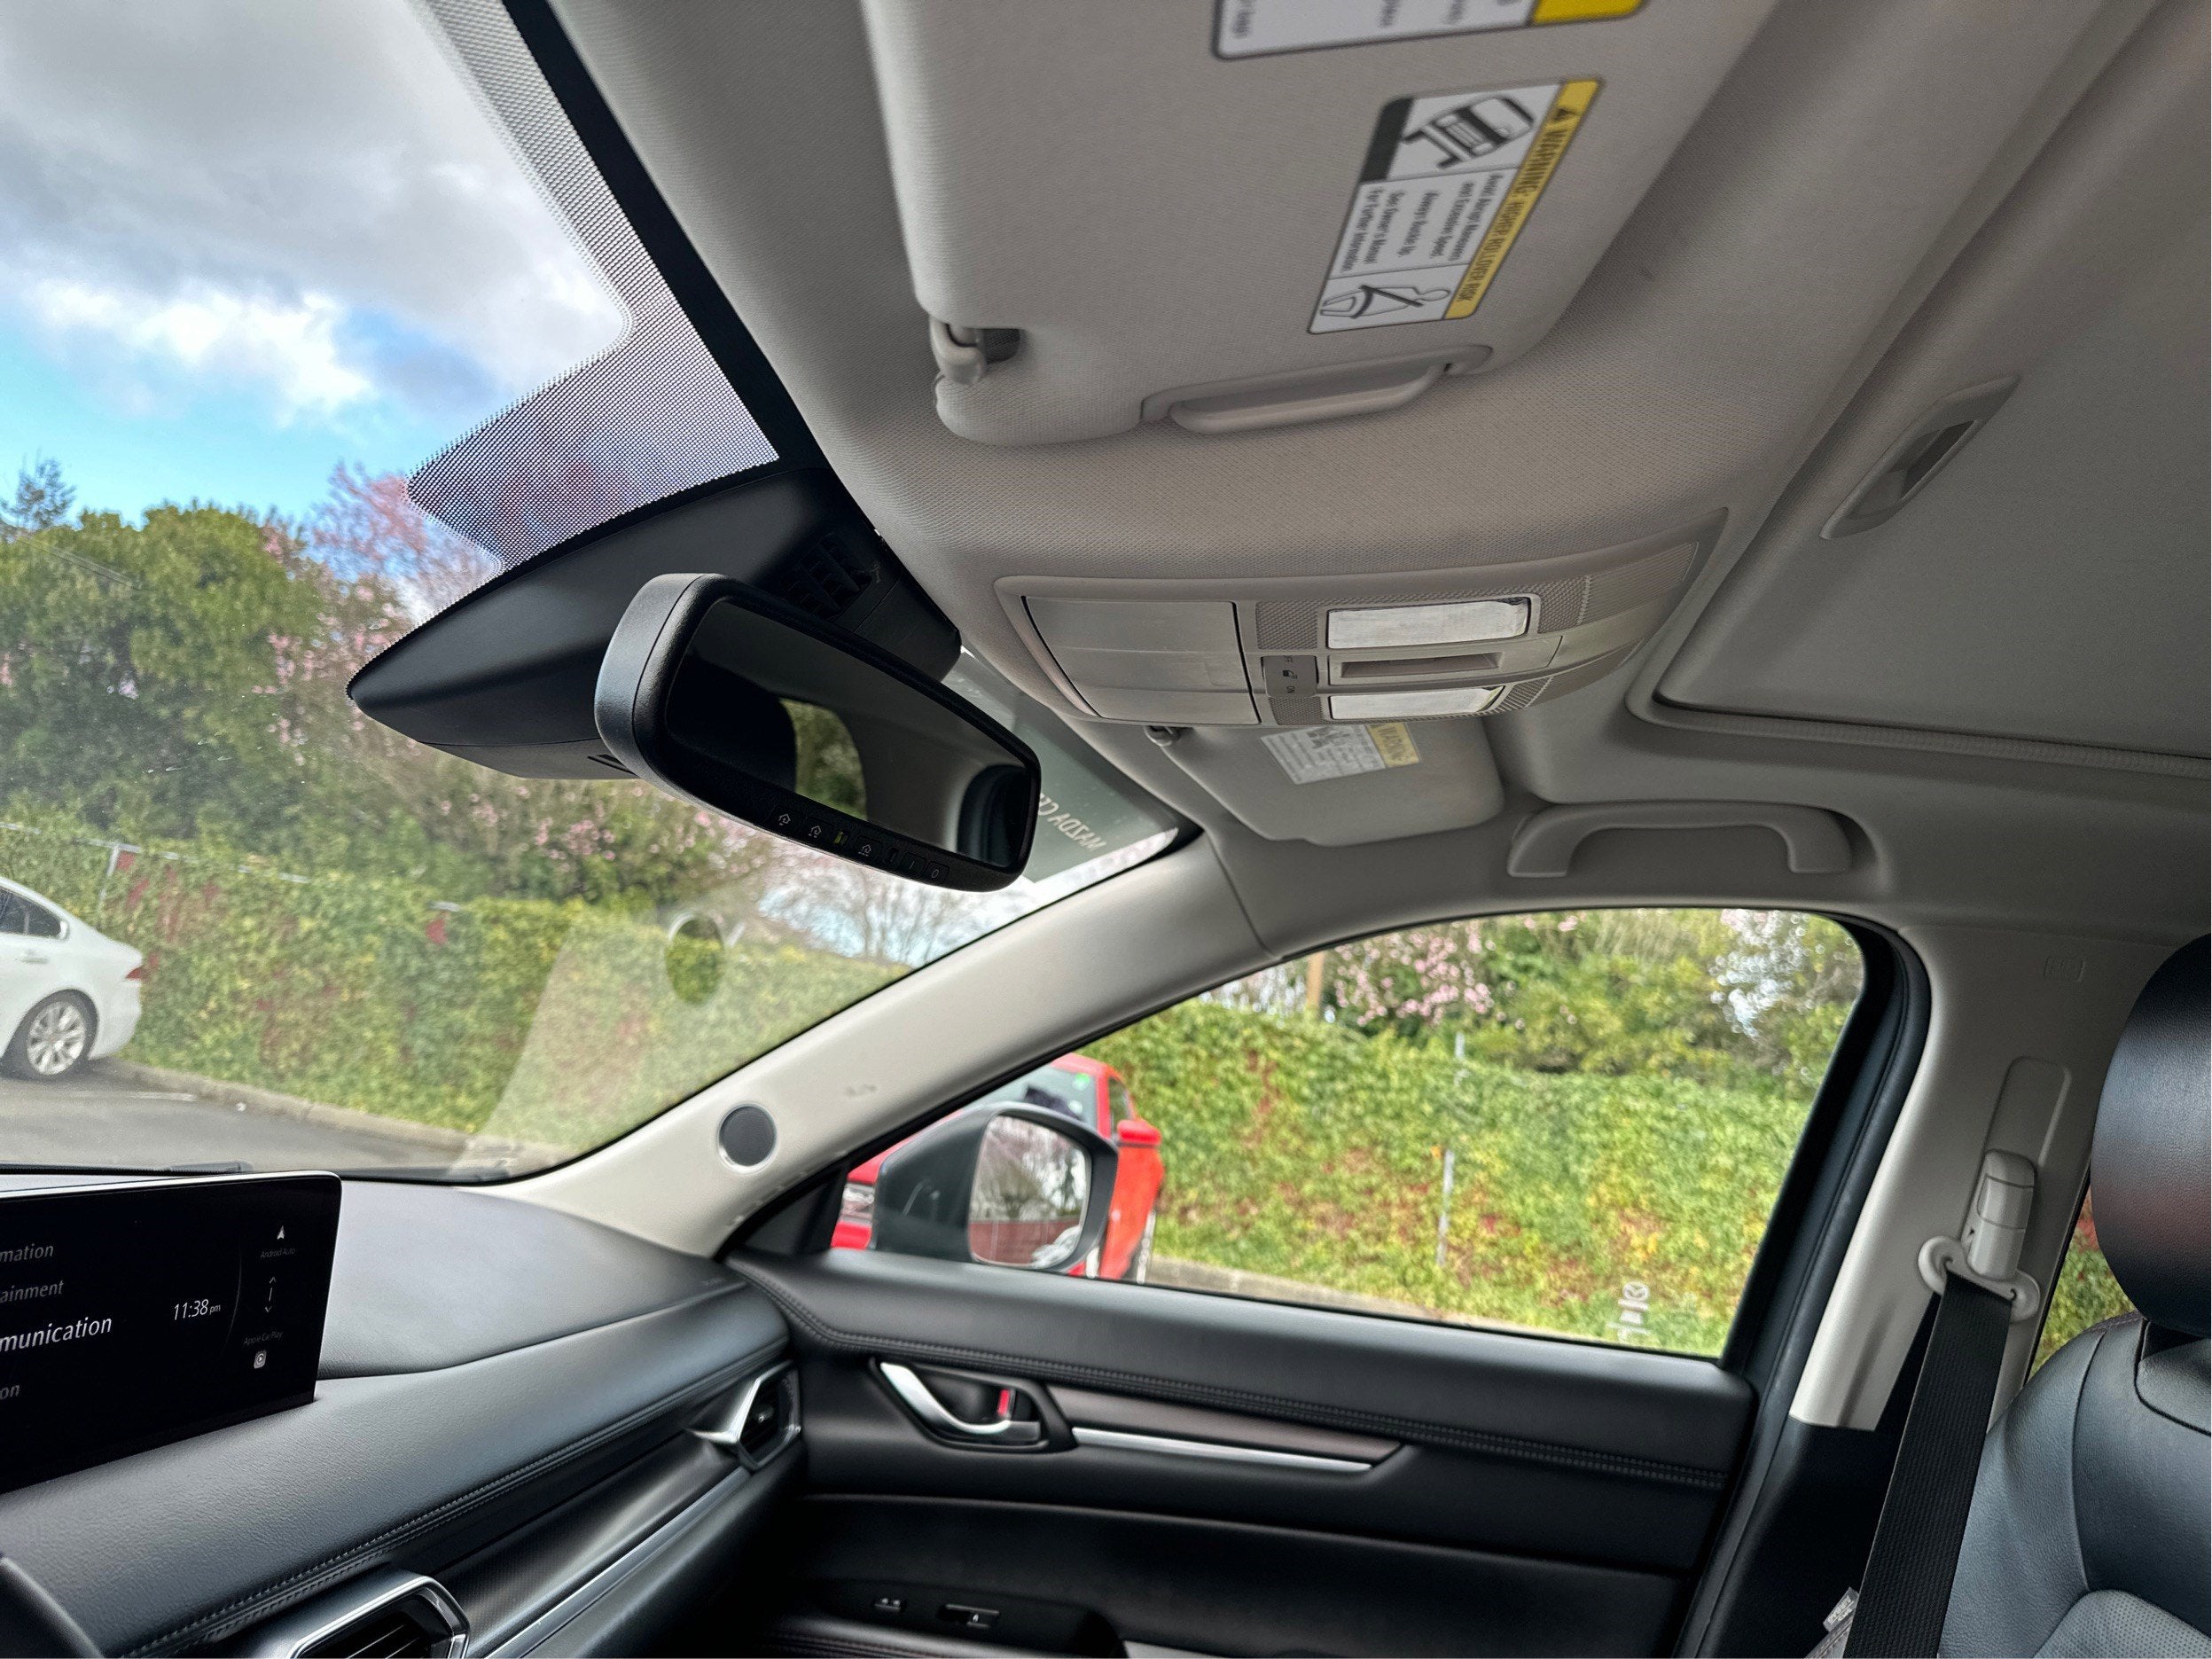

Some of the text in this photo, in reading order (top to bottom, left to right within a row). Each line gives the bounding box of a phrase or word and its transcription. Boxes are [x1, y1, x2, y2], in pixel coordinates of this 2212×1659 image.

[1489, 200, 1526, 236] HIGHER
[1466, 238, 1505, 281] ROLLOVER
[1455, 282, 1480, 302] RISK
[174, 1298, 221, 1320] 11:38 pm
